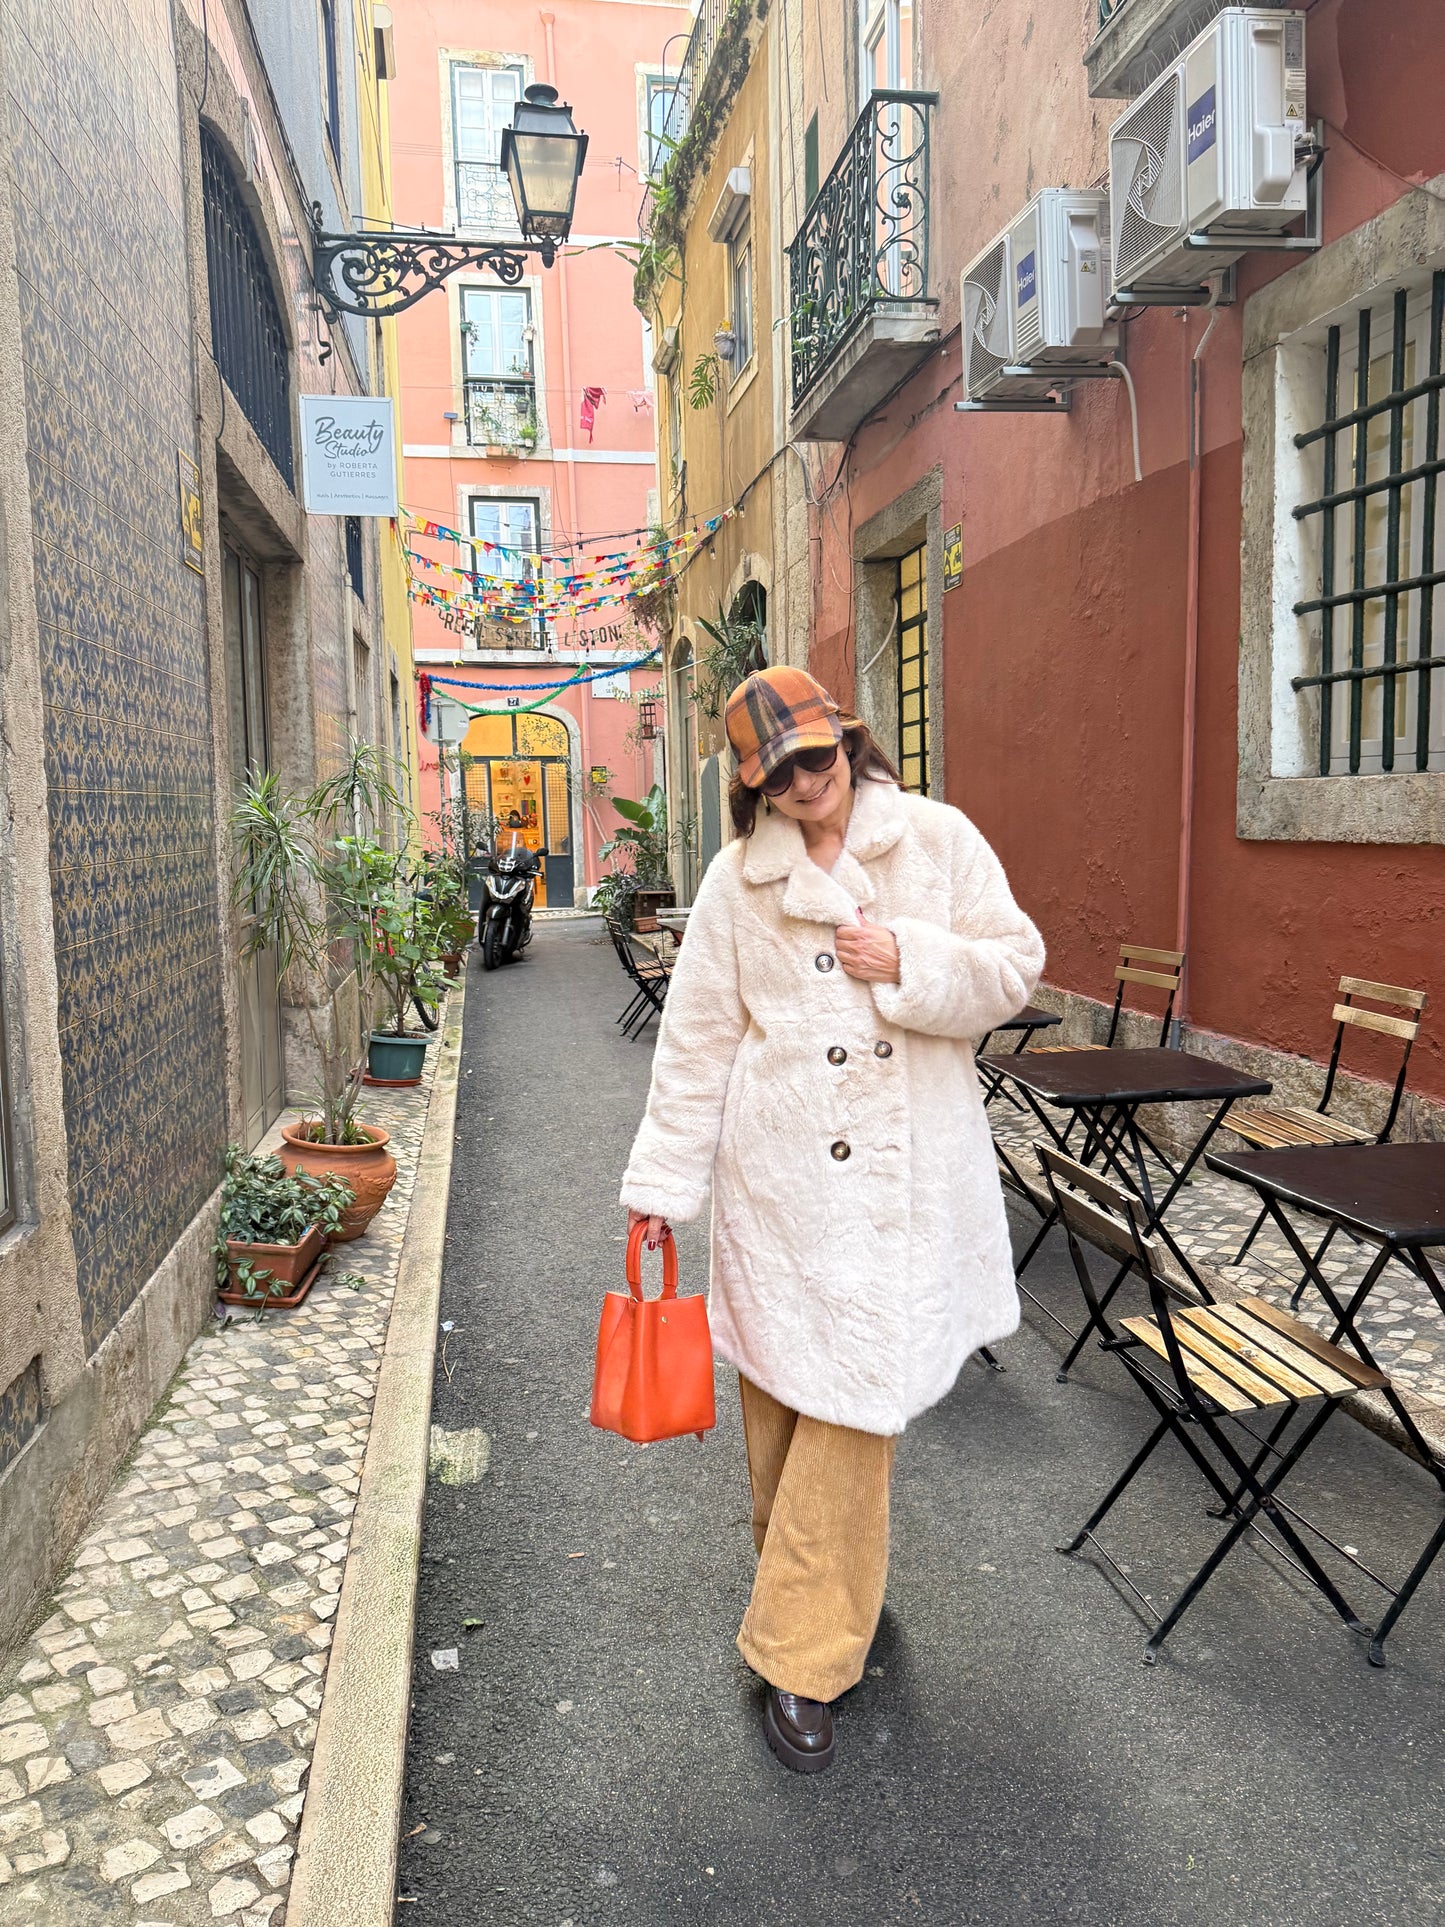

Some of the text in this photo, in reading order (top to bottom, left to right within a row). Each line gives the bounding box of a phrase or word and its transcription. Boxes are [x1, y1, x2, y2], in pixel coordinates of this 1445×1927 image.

[1188, 109, 1215, 145] Haier
[1017, 269, 1035, 293] Haier
[314, 416, 384, 454] Beauty
[324, 440, 369, 459] Studio
[327, 462, 337, 470] by
